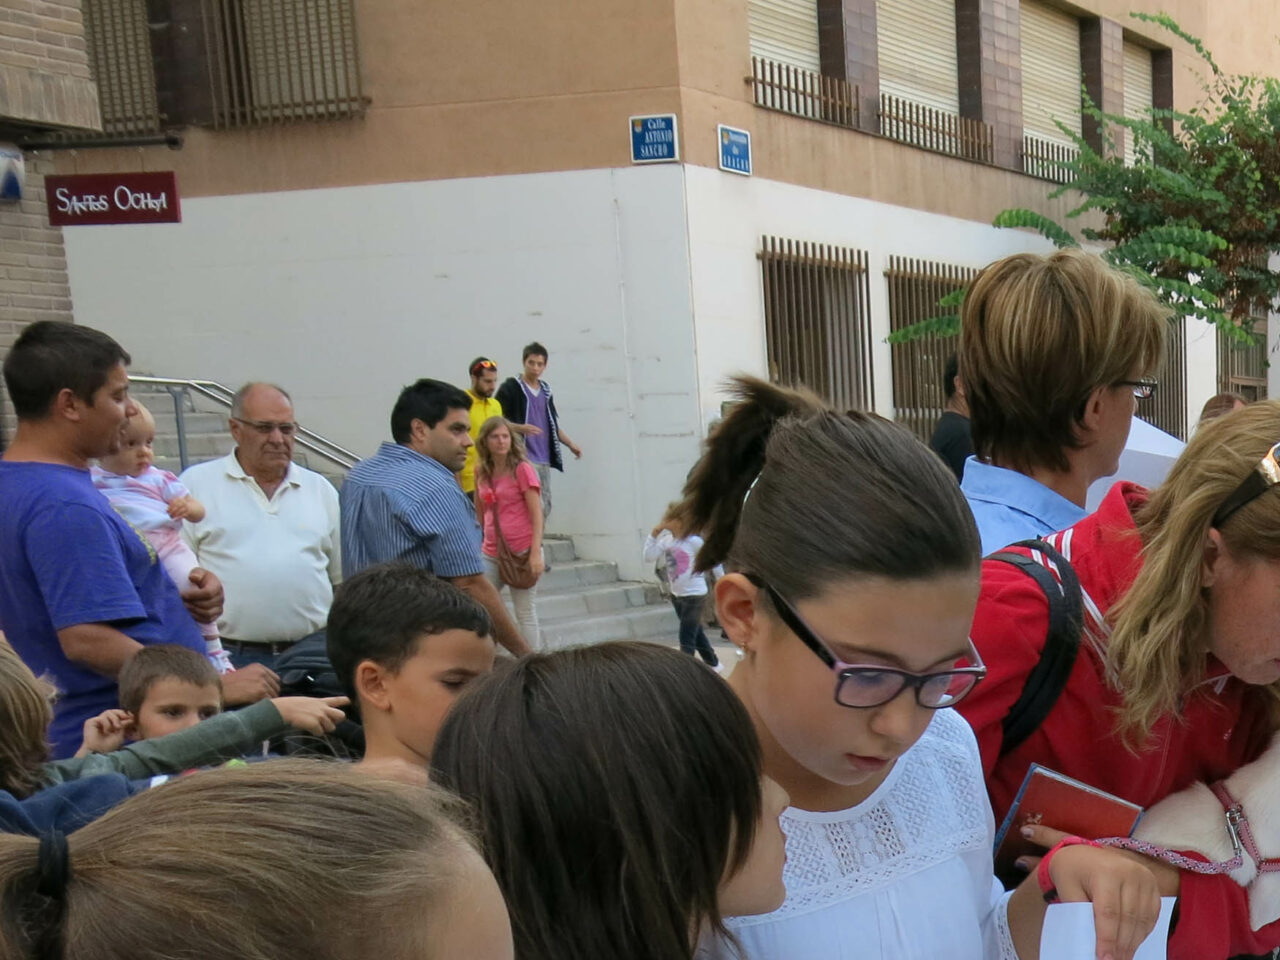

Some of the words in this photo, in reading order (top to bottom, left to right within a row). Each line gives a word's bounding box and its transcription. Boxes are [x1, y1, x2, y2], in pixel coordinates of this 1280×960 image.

[648, 119, 666, 129] Calle
[644, 130, 673, 144] ANTONIO
[640, 143, 668, 158] SANCHO
